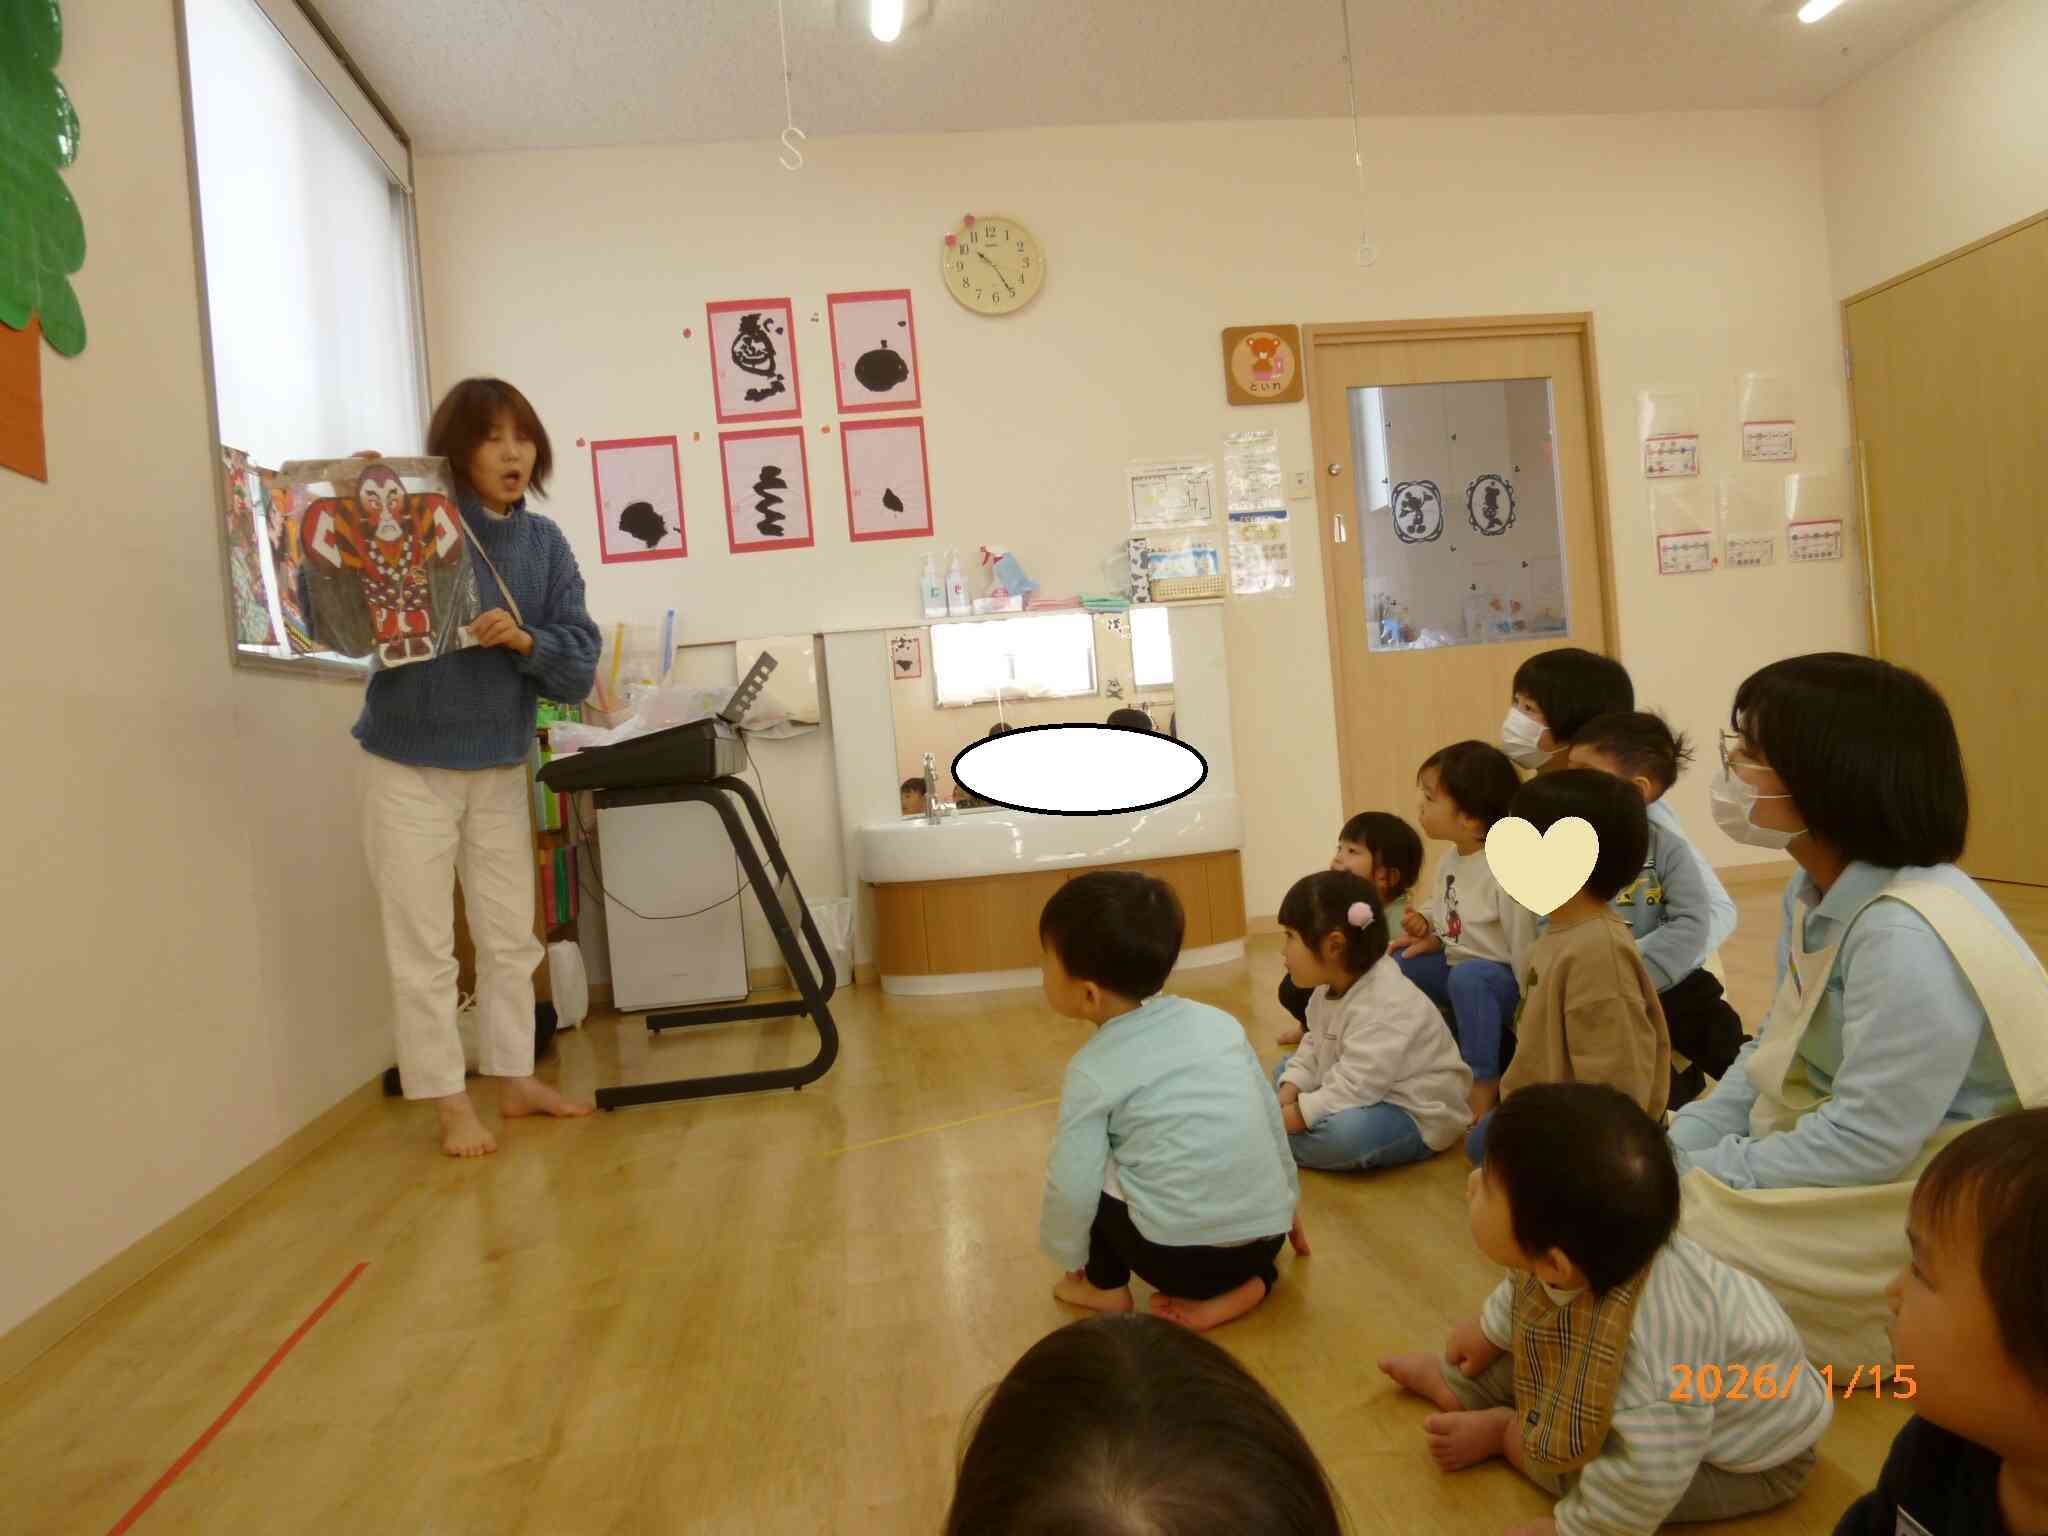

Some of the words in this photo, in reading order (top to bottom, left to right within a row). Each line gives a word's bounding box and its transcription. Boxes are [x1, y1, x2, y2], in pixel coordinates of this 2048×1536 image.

[985, 224, 996, 238] 12
[1004, 230, 1009, 241] 1
[970, 231, 978, 244] 11
[960, 243, 969, 255] 10
[1017, 240, 1024, 252] 2
[956, 261, 964, 272] 9
[1022, 257, 1030, 269] 3
[962, 276, 970, 288] 8
[1018, 272, 1025, 284] 4
[976, 289, 982, 300] 7
[992, 292, 1000, 304] 6
[1009, 287, 1016, 298] 5
